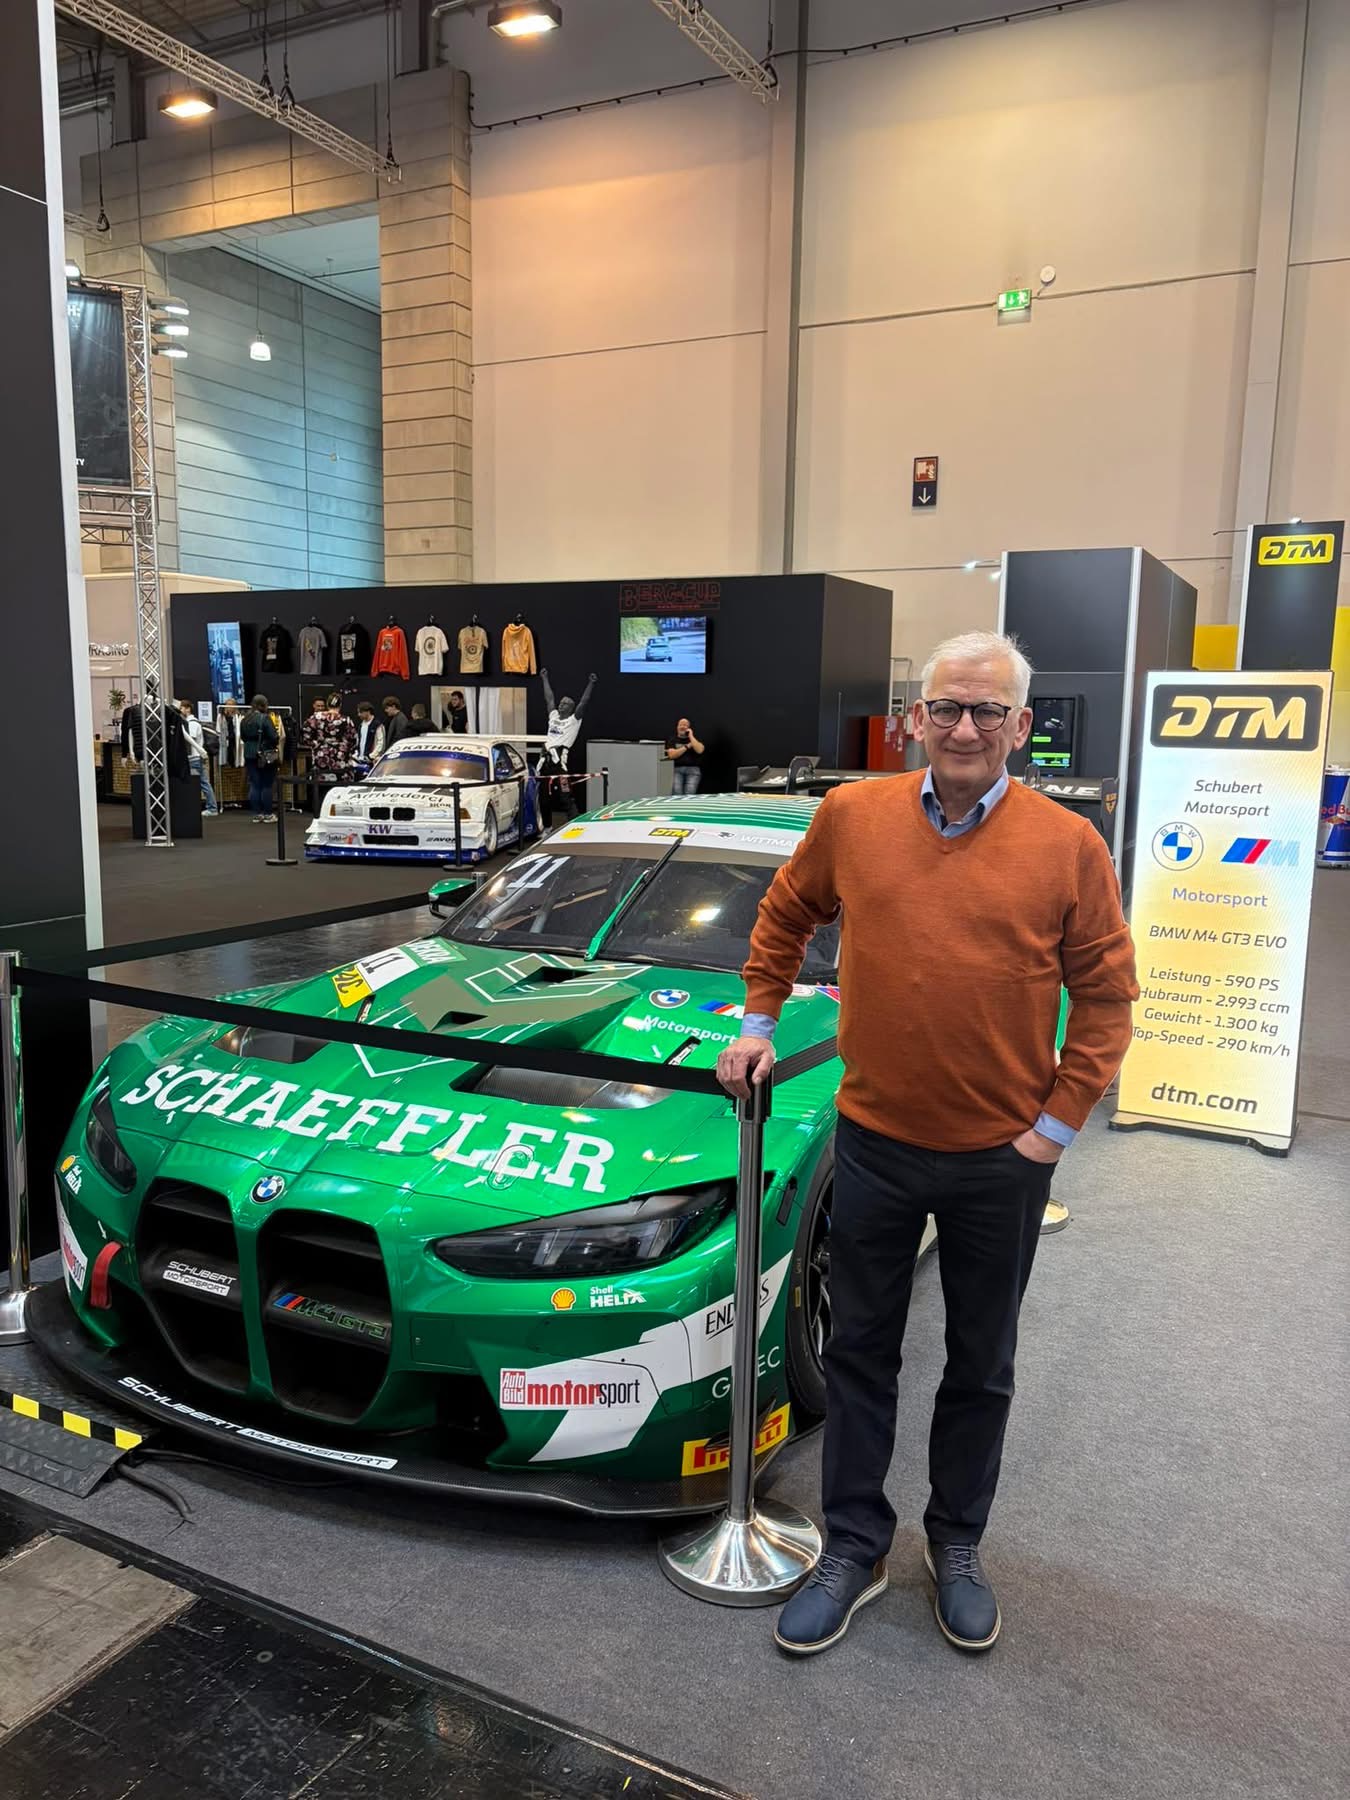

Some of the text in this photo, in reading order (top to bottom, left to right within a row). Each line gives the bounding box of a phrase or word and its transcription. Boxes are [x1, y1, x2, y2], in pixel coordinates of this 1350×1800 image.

[1263, 540, 1327, 560] DTM
[1160, 695, 1307, 739] DTM
[1194, 779, 1263, 794] Schubert
[1184, 801, 1271, 818] Motorsport
[368, 824, 392, 834] KW
[740, 833, 799, 848] WITTMA
[506, 856, 571, 888] 11
[1172, 887, 1268, 908] Motorsport
[1149, 925, 1288, 949] BMW M4 GT3 EVO
[1149, 967, 1212, 987] Leistung
[1224, 974, 1256, 989] 590
[1258, 978, 1281, 992] PS
[1215, 994, 1257, 1010] 2.993
[1259, 1001, 1291, 1015] ccm
[642, 1014, 740, 1044] Motorsport
[1144, 1007, 1203, 1026] Gewicht
[1214, 1015, 1258, 1032] 1.300
[1260, 1020, 1280, 1037] kg
[1132, 1025, 1206, 1046] Top-Speed
[1216, 1036, 1248, 1051] 290
[1249, 1040, 1291, 1057] km/h
[1151, 1082, 1259, 1115] dtm.com
[119, 1063, 616, 1194] SCHAEFFLER
[165, 1271, 228, 1294] MOTORSPORT
[167, 1260, 237, 1285] SCHUBERT
[589, 1287, 648, 1309] HELIX
[590, 1284, 614, 1296] Shell
[502, 1372, 525, 1388] Auto
[503, 1388, 525, 1403] Bild
[117, 1376, 389, 1467] SCHUBERT MOTORSPORT
